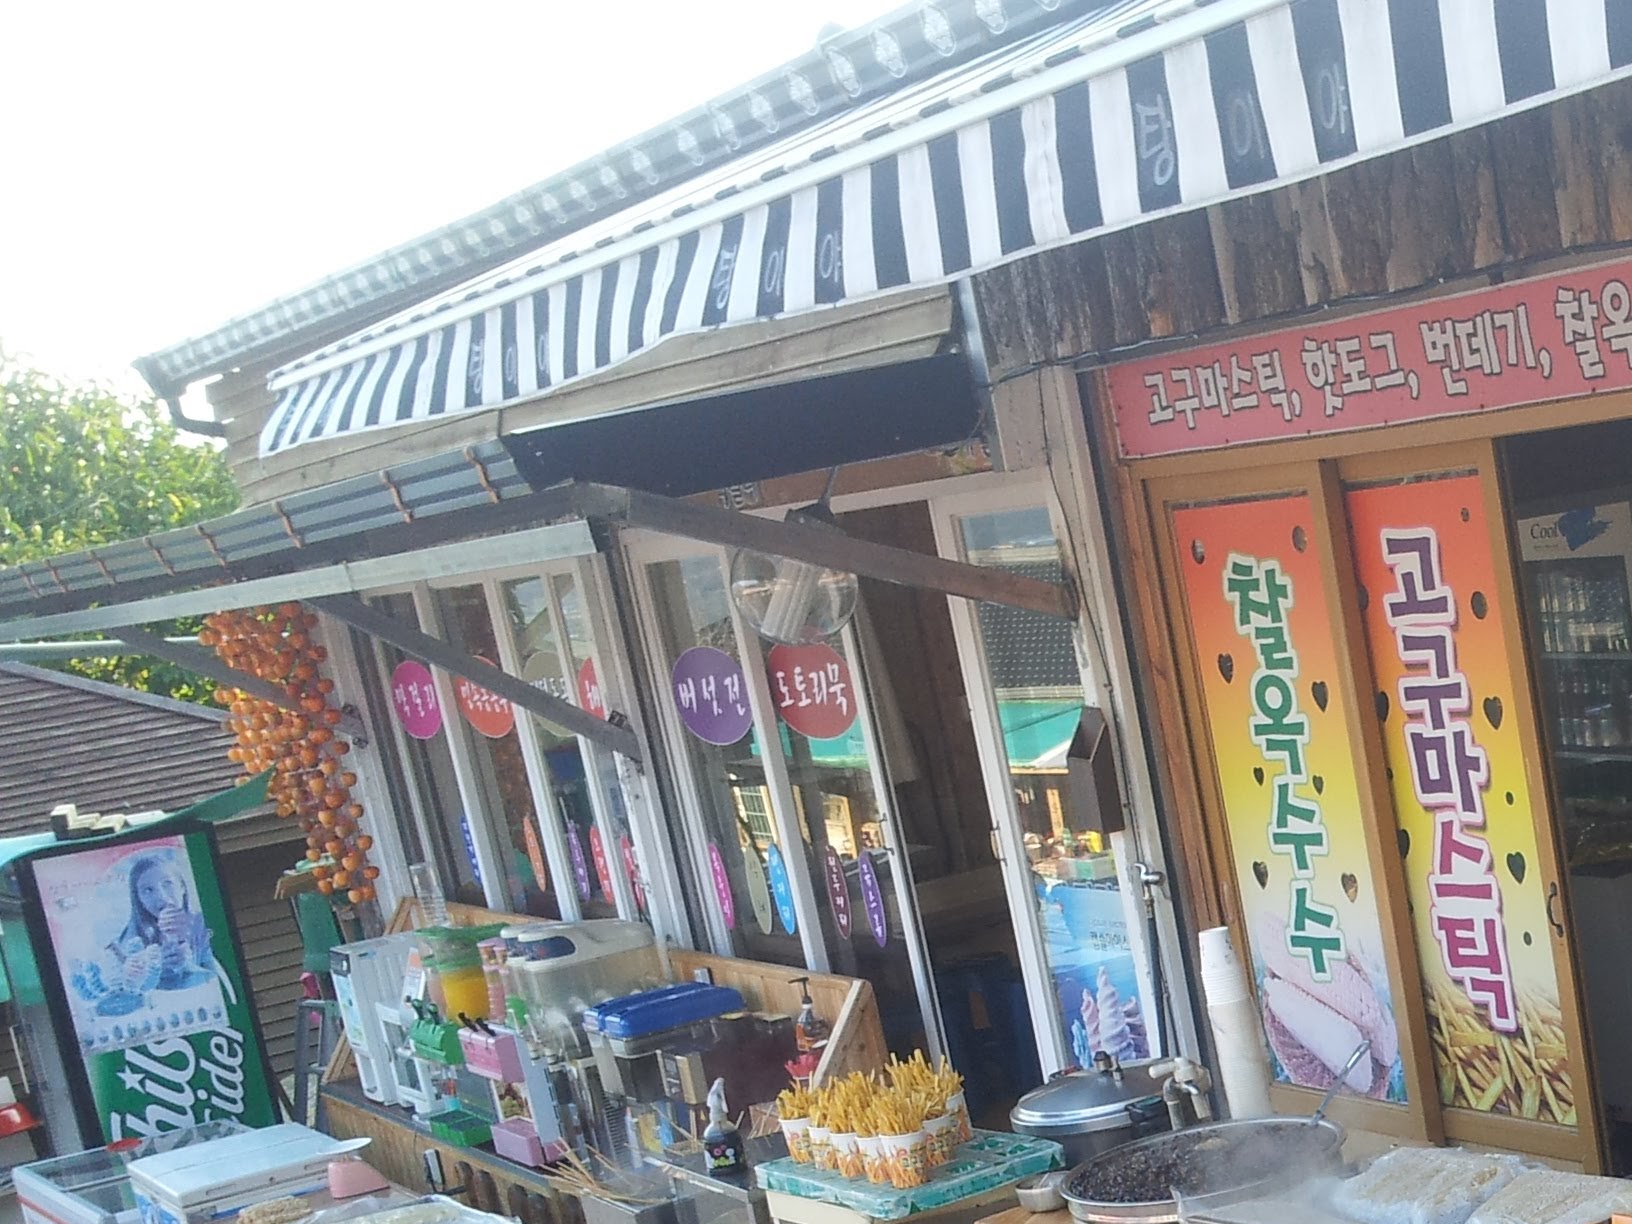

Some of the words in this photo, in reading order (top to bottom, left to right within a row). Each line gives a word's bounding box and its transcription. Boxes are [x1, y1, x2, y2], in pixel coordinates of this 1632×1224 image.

[1142, 351, 1301, 429] 고구마스틱,
[1302, 332, 1419, 418] 핫도그,
[1419, 303, 1551, 396] 번데기,
[678, 673, 746, 717] 버섯전
[775, 662, 848, 716] 도토리묵
[1224, 555, 1346, 982] 찰옥수수
[1382, 529, 1518, 1030] 고구마스틱
